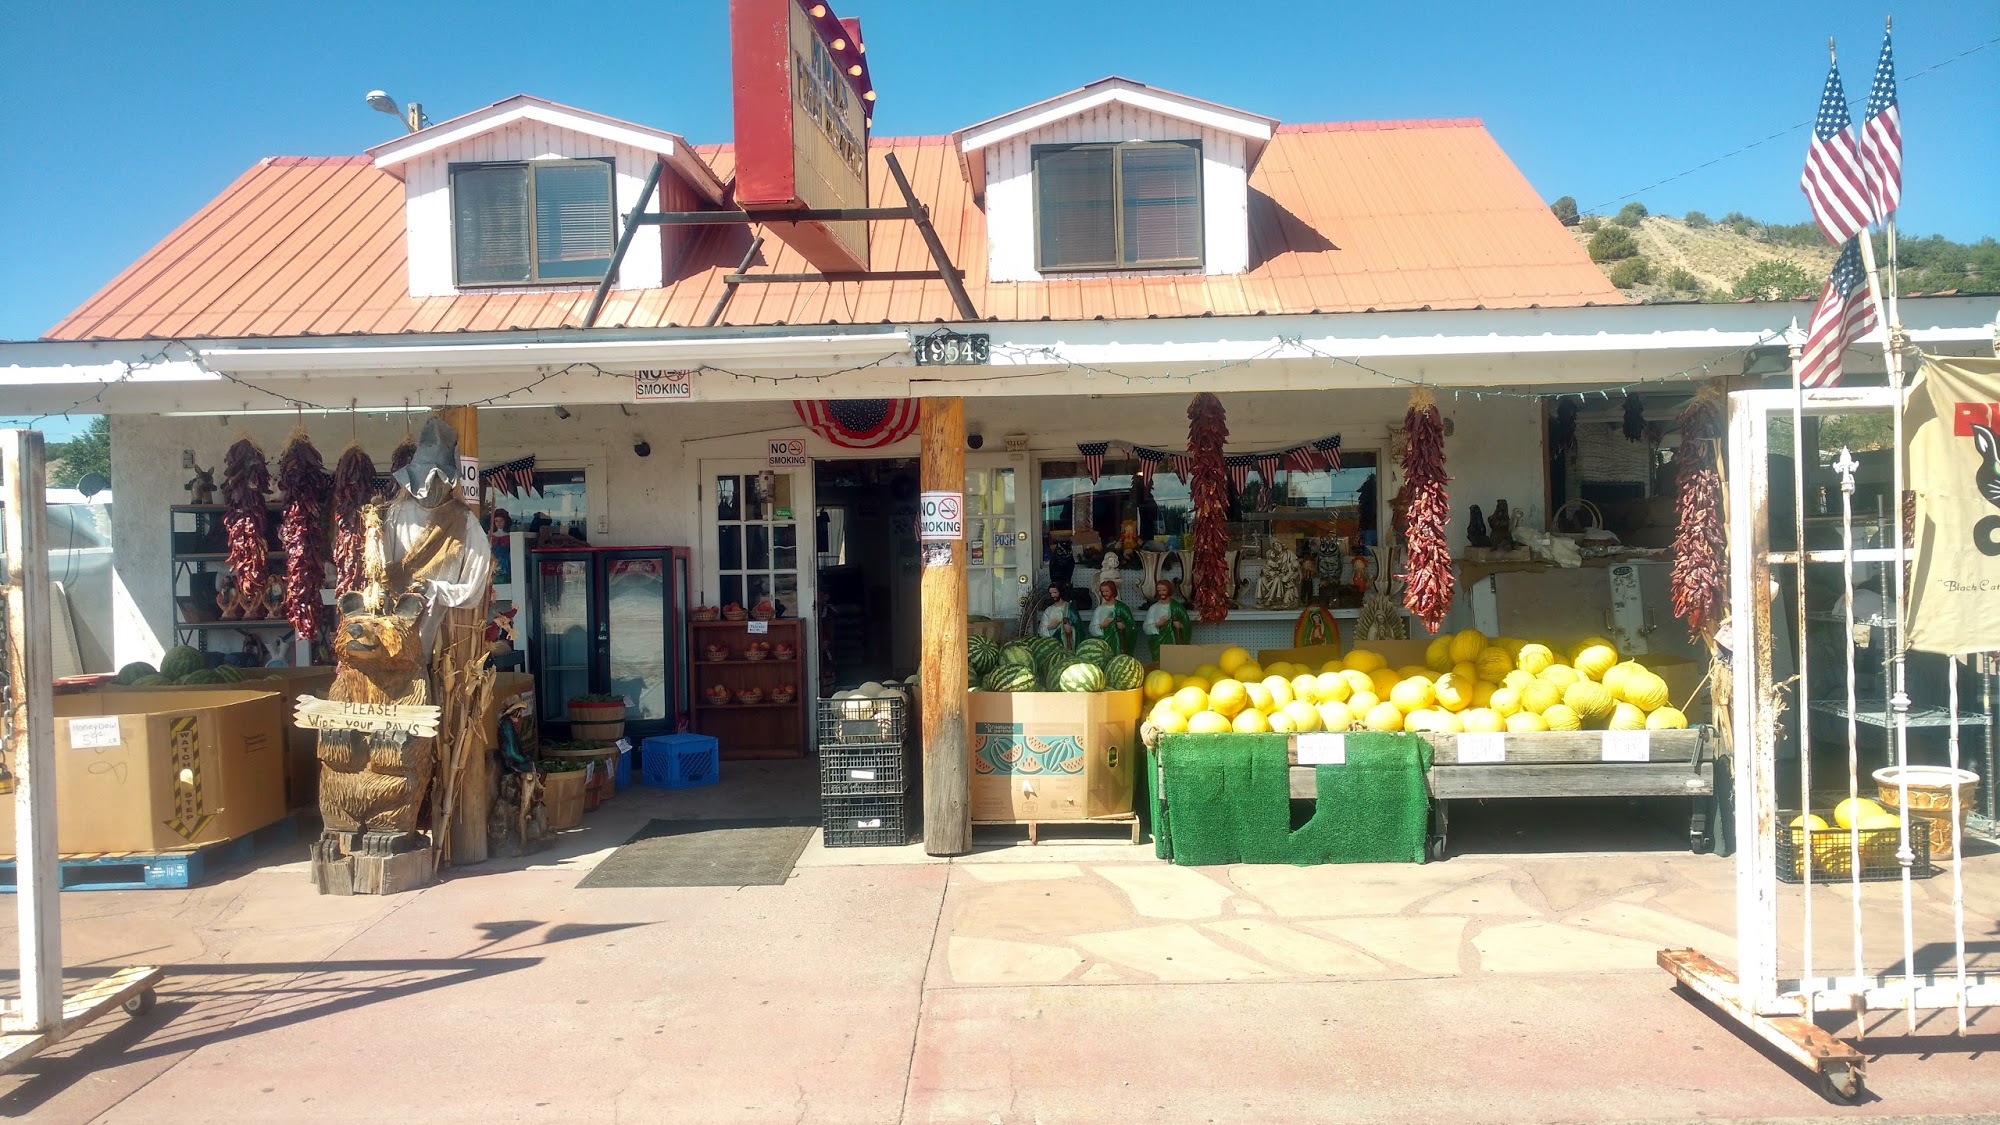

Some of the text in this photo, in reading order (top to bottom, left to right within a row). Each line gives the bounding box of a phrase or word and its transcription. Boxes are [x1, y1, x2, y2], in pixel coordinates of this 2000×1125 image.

[917, 337, 988, 362] 19543
[637, 383, 689, 395] SMOKING
[771, 443, 787, 454] NO
[770, 456, 805, 465] SMOKING
[921, 521, 960, 532] MOKING
[994, 534, 1015, 546] PUSH
[344, 702, 398, 717] PLEASE!
[180, 731, 194, 821] WATCH STEP
